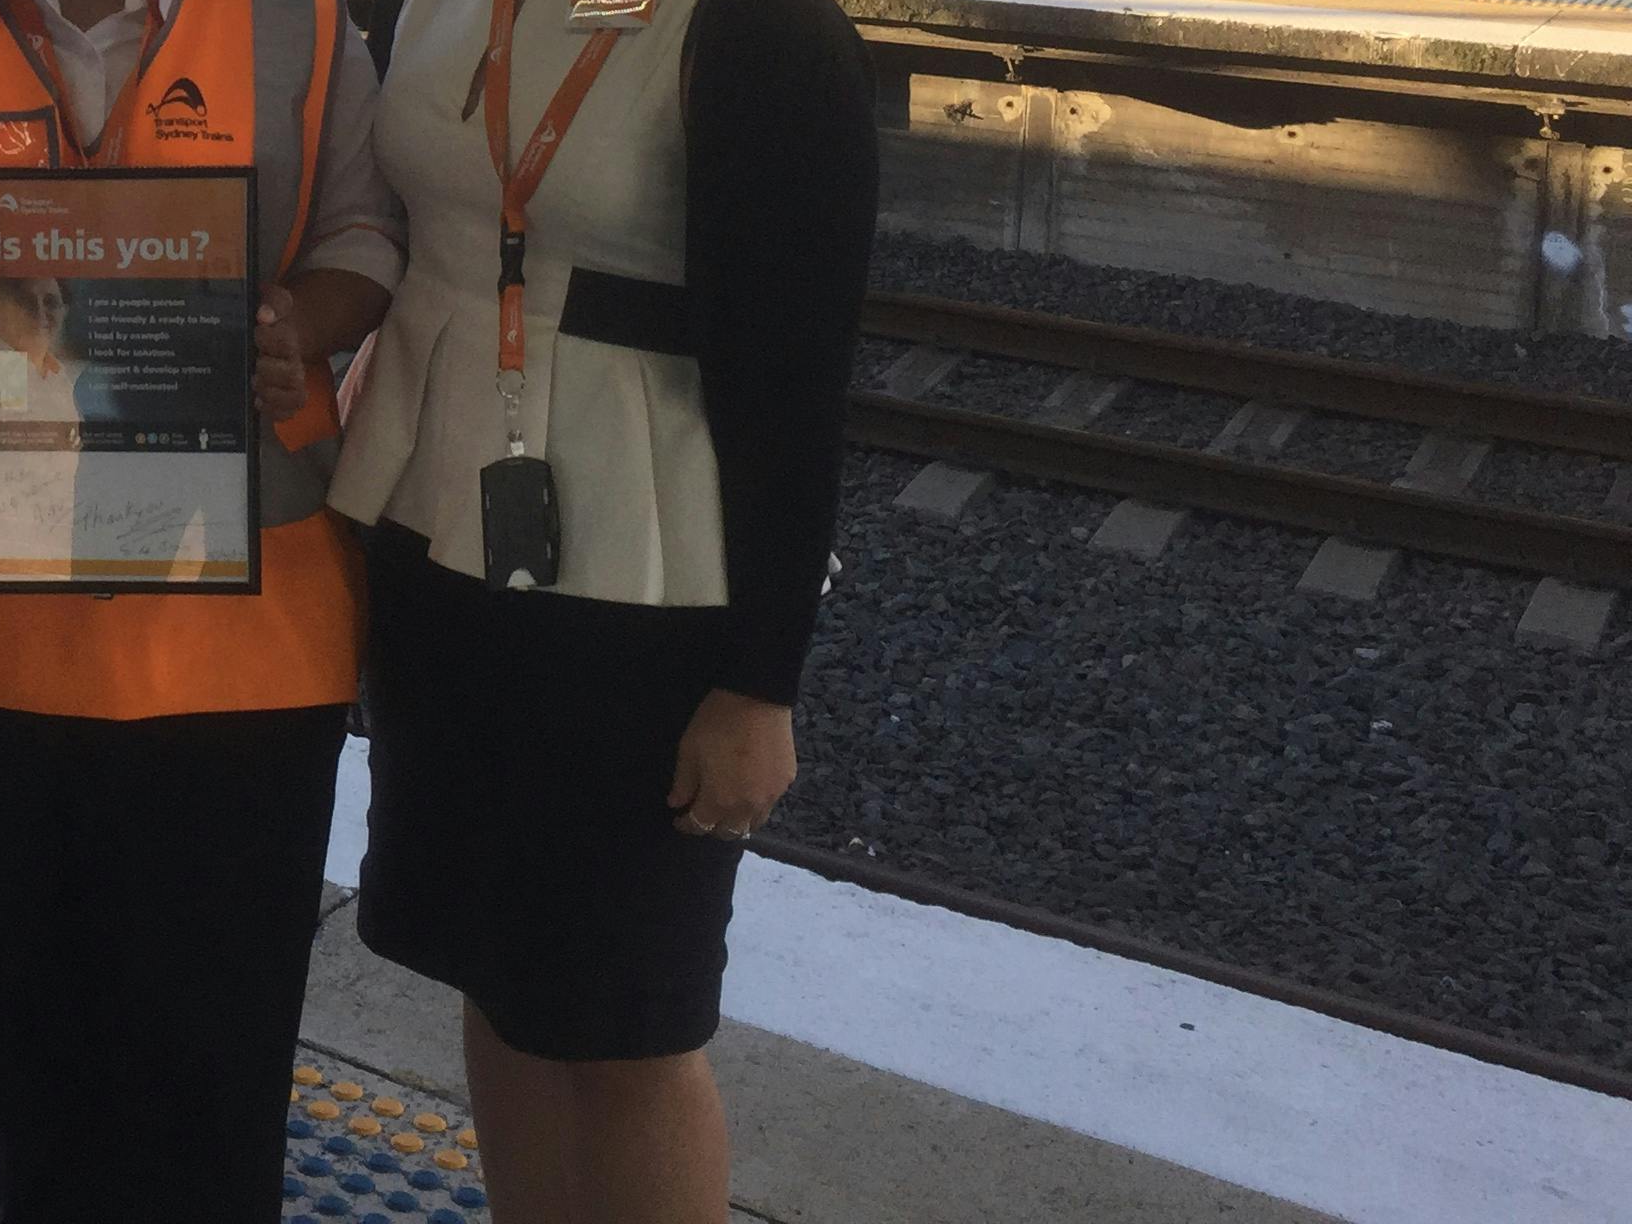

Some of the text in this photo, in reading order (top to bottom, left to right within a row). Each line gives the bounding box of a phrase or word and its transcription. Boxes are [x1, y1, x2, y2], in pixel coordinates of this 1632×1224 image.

[154, 118, 208, 129] Transport
[155, 129, 234, 142] Sydney Trains
[32, 227, 105, 262] this
[115, 229, 211, 270] you?
[118, 298, 151, 309] people
[152, 299, 186, 309] person
[111, 314, 147, 326] friendly
[158, 315, 186, 326] ready
[186, 315, 198, 324] to
[198, 315, 221, 326] help
[128, 331, 171, 342] example
[94, 348, 114, 357] look
[116, 348, 130, 357] for
[132, 348, 176, 357] solutions
[142, 364, 180, 376] develop
[180, 365, 212, 374] others
